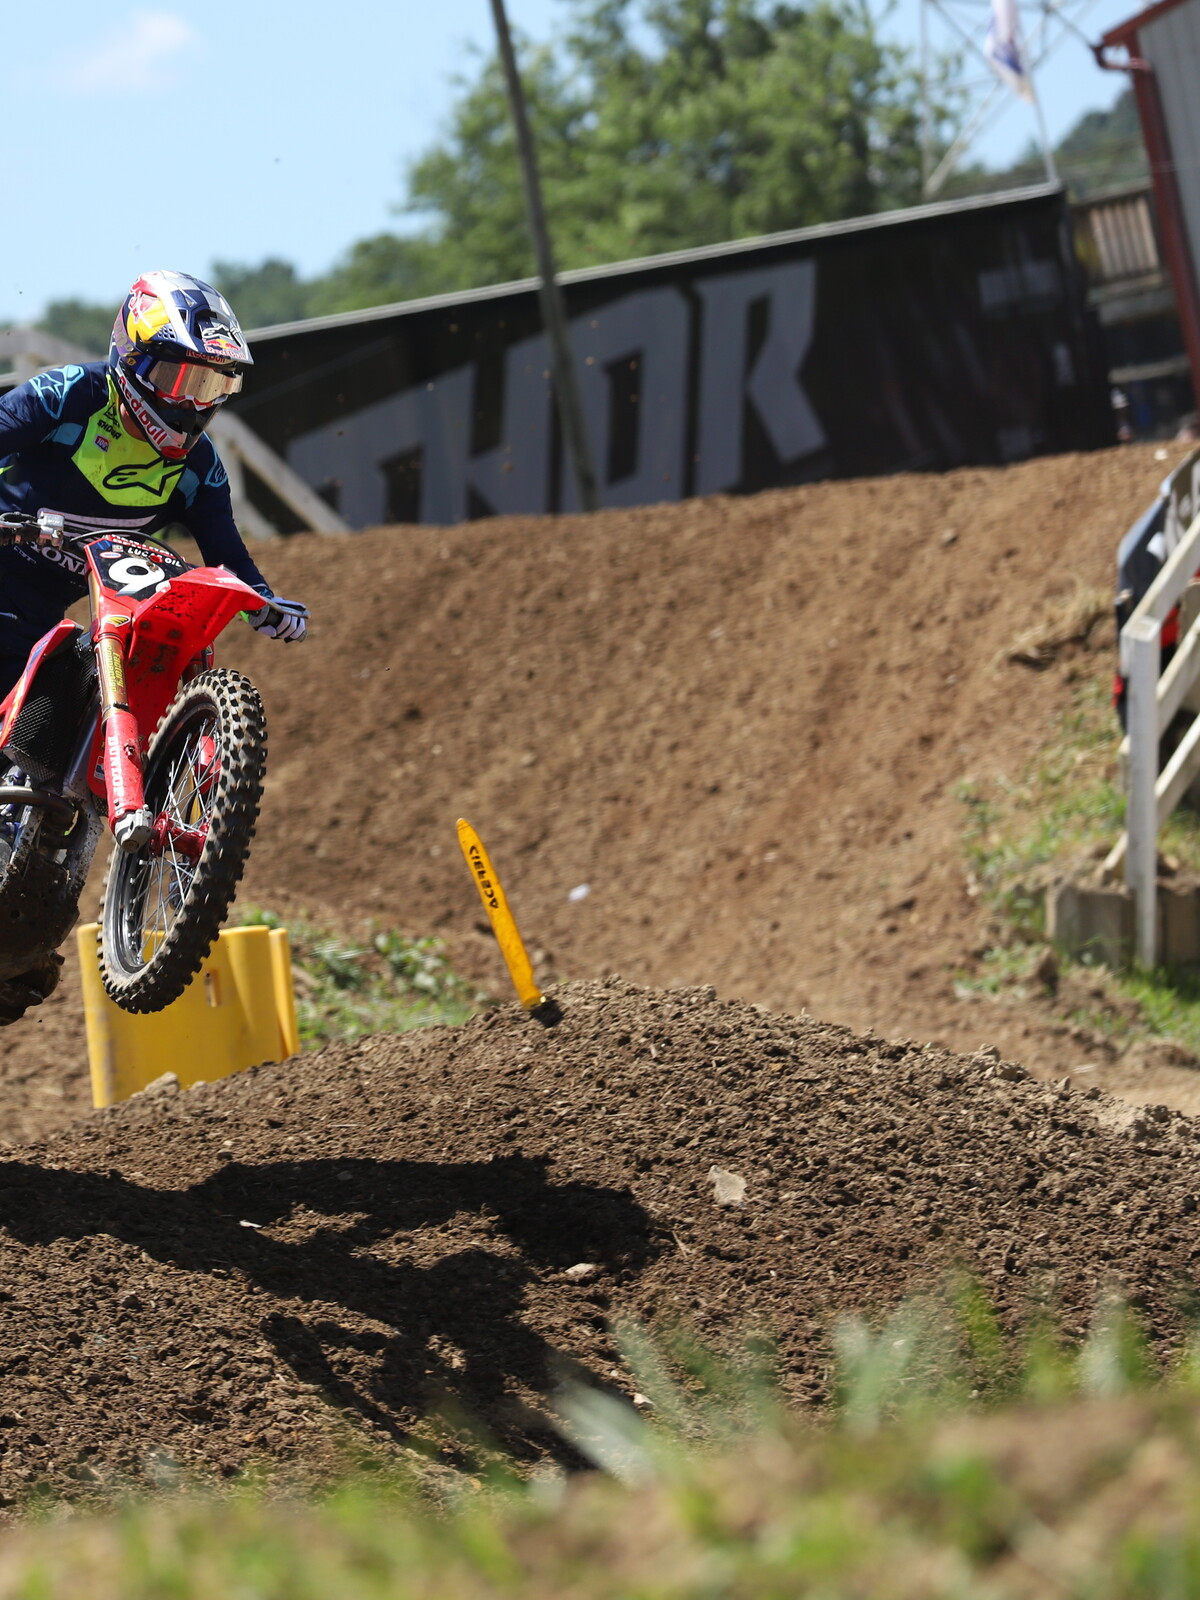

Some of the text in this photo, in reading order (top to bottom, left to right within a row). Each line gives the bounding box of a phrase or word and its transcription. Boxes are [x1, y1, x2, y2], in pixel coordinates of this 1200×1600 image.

[285, 258, 826, 530] THOR
[108, 557, 171, 598] 9
[164, 557, 182, 567] OIL
[107, 735, 125, 797] DUNLOP
